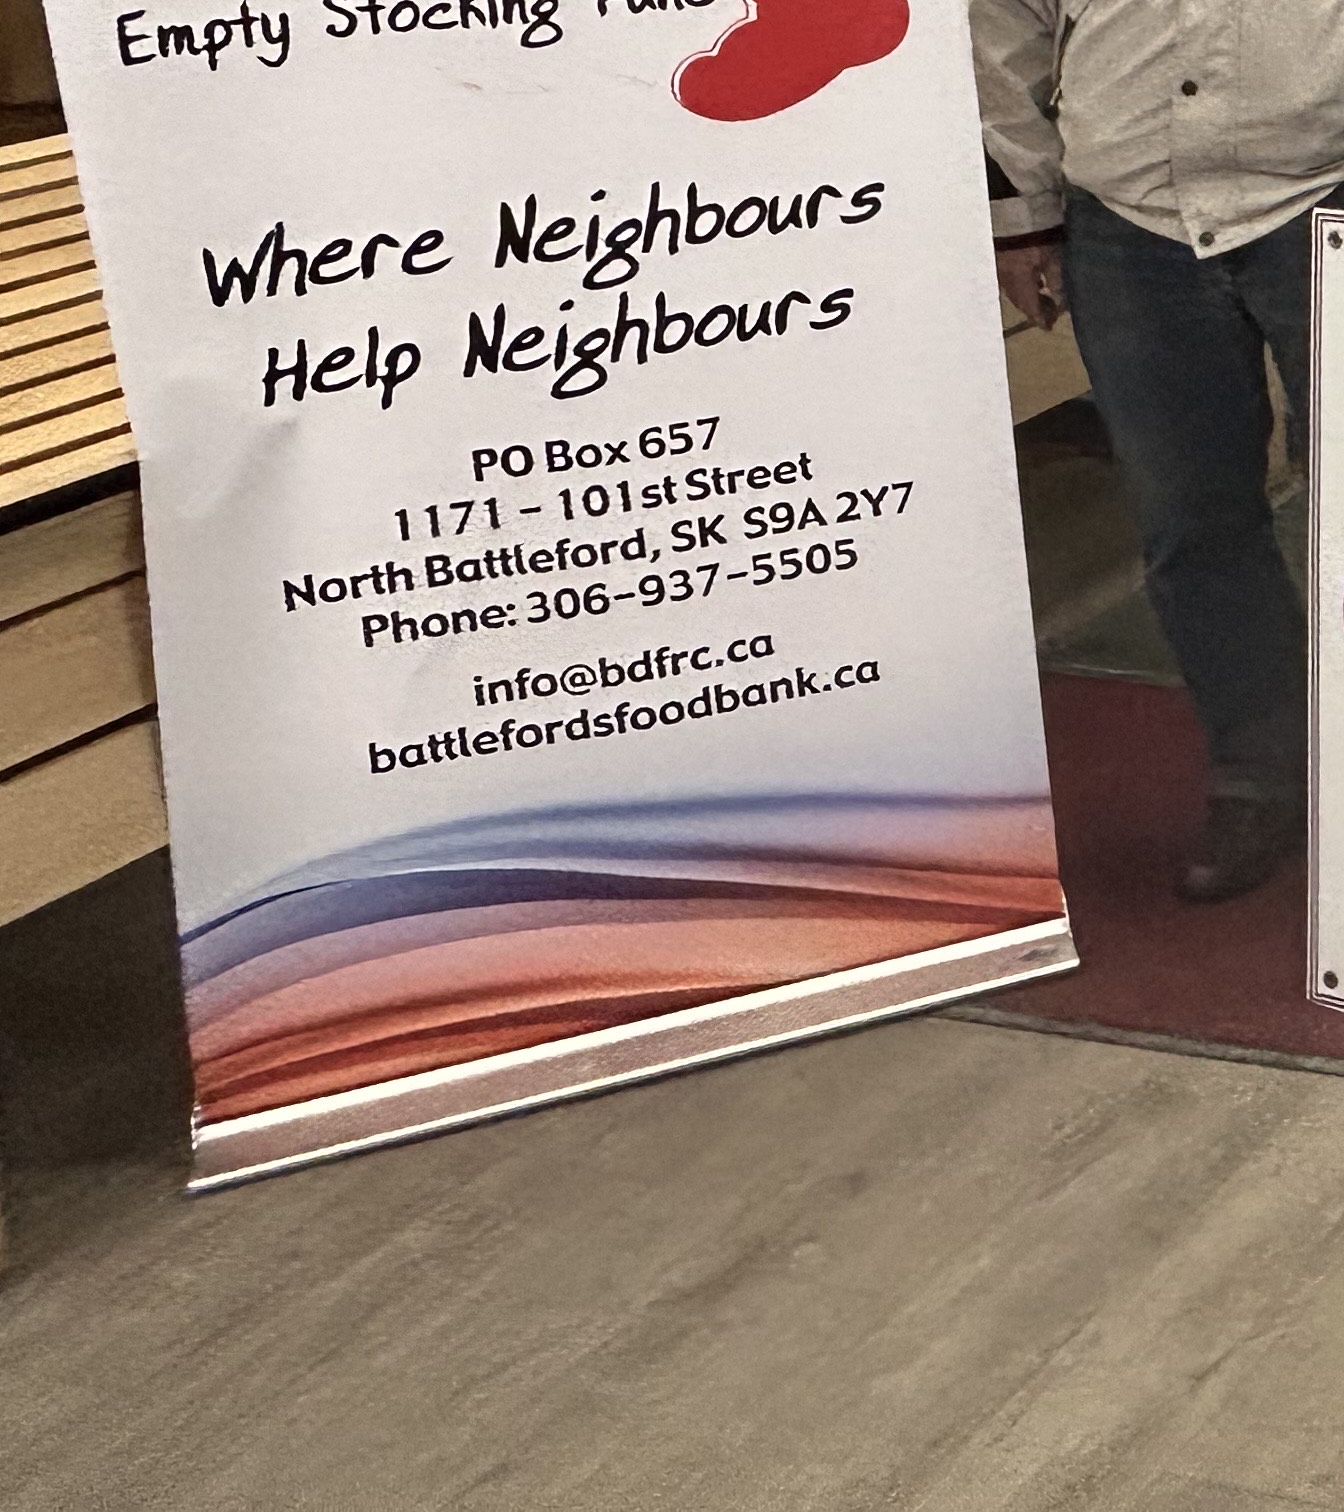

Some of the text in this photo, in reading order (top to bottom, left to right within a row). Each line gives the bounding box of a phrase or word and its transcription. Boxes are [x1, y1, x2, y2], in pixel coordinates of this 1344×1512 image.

[202, 181, 885, 308] Where Neighbours
[261, 287, 854, 411] Help Neighbours
[394, 497, 501, 542] 1171
[558, 475, 678, 521] 101st
[684, 452, 813, 501] Street
[471, 416, 720, 482] PO Box 657
[282, 481, 914, 613] North Battleford, SK S9A 2Y7
[361, 538, 858, 648] Phone: 306-937-5505
[368, 660, 881, 774] battlefordsfoodbank.ca
[473, 634, 775, 707] info@bdfrc.ca
